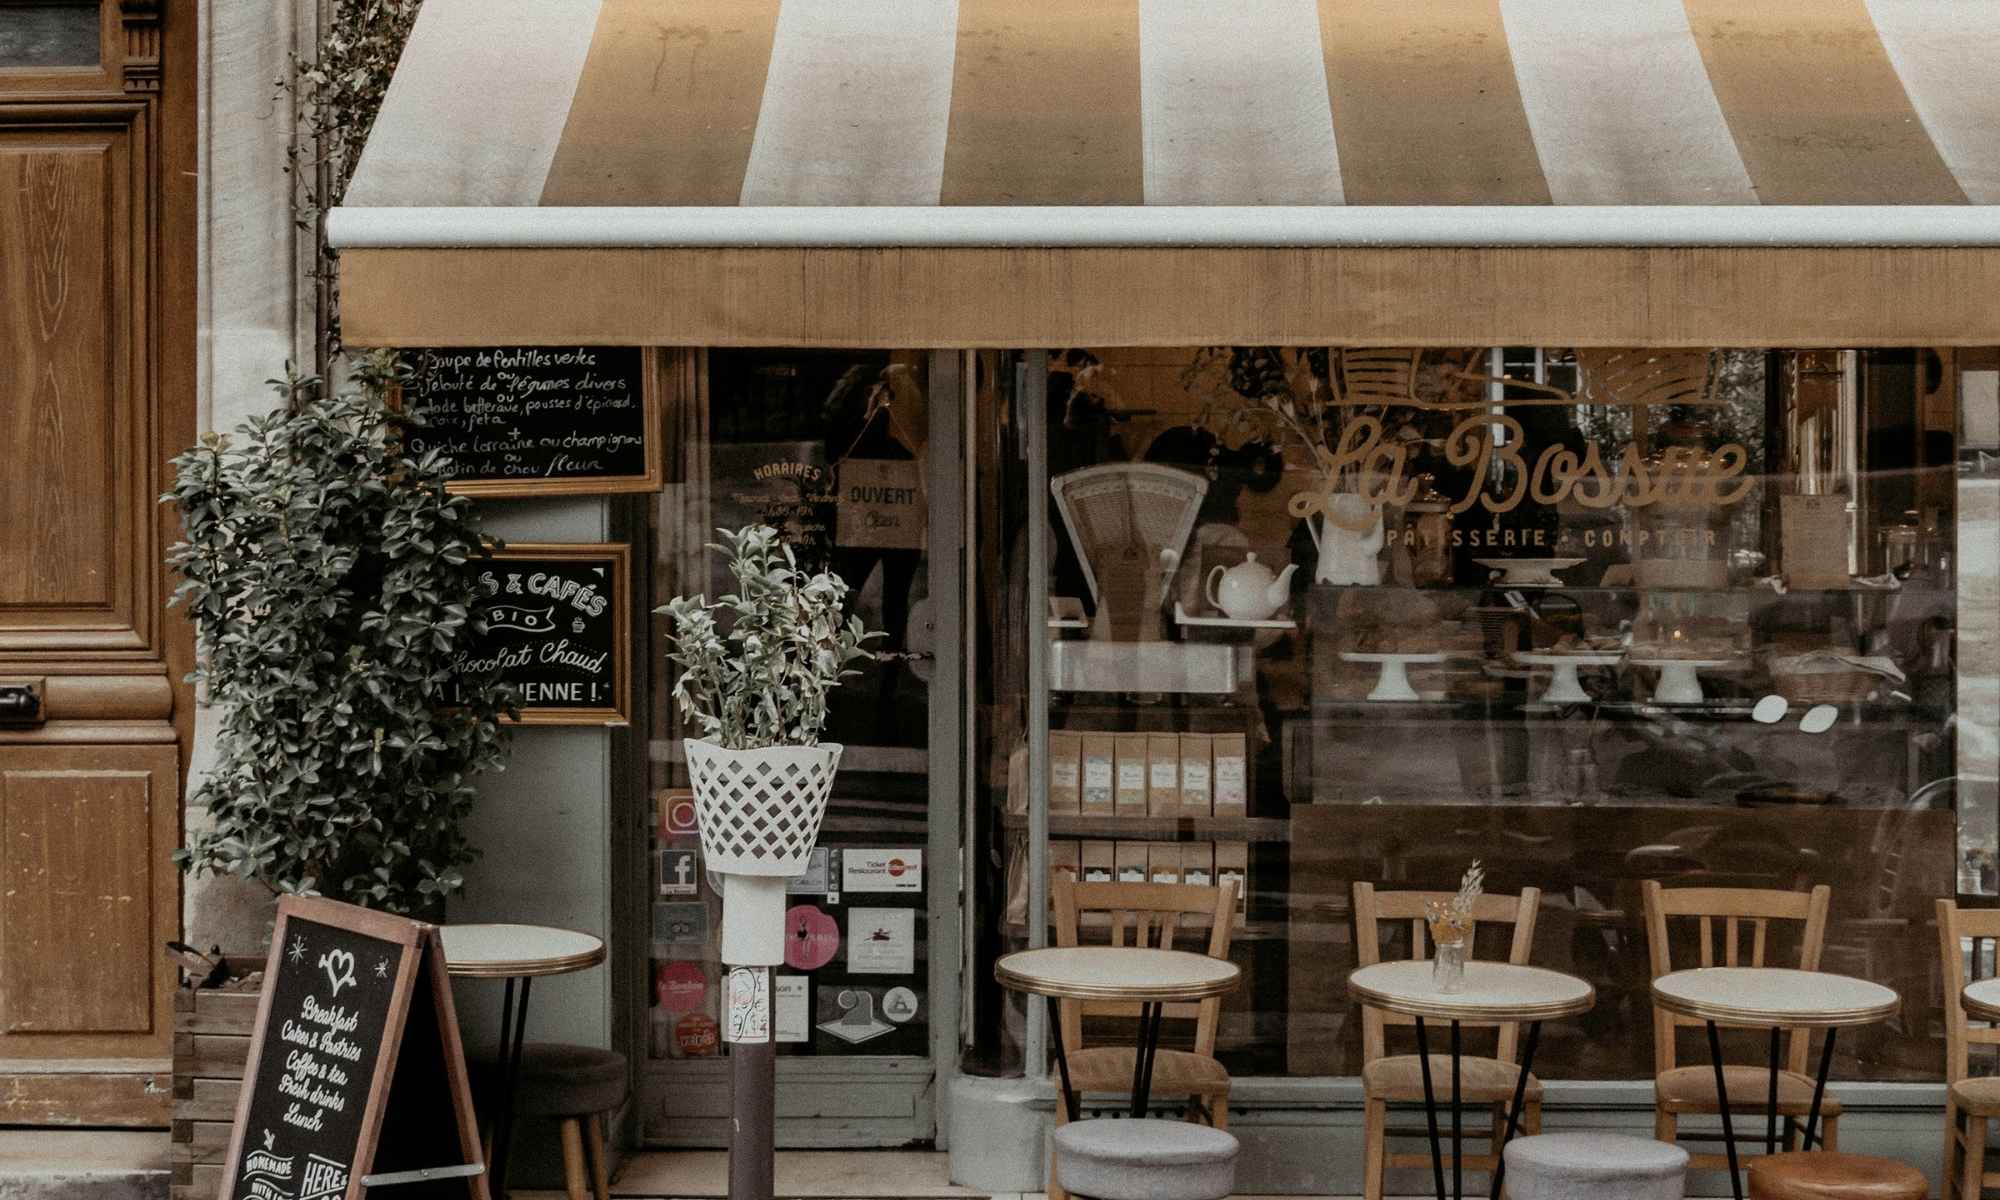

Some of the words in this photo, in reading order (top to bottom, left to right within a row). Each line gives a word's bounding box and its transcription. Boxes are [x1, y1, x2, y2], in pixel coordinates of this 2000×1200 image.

[476, 351, 493, 368] de
[553, 347, 596, 367] vertes
[480, 374, 497, 391] de
[506, 374, 570, 399] légumes
[575, 372, 627, 391] divers
[497, 371, 516, 381] ou
[496, 393, 515, 403] ou
[525, 400, 570, 416] pousses
[467, 413, 507, 433] feta
[540, 436, 561, 448] ou
[480, 458, 497, 474] de
[503, 461, 540, 476] chou
[503, 453, 522, 463] ou
[752, 462, 822, 481] HORAIRES
[850, 486, 913, 505] OUVERT
[1583, 528, 1717, 548] COMPTR
[527, 572, 608, 618] CAFÉS
[492, 610, 538, 626] BIO
[452, 645, 533, 673] hocolat
[539, 638, 608, 674] Chaud
[301, 995, 359, 1034] Breakfast
[281, 1019, 309, 1045] Cakes
[308, 1031, 318, 1048] &
[319, 1034, 362, 1062] Pastries
[286, 1050, 320, 1081] Coffee
[318, 1066, 328, 1080] &
[327, 1065, 349, 1086] tea
[278, 1074, 311, 1100] Fresh
[309, 1087, 346, 1112] drinks
[283, 1102, 324, 1133] Lunch
[246, 1156, 293, 1175] HOMEMADE
[301, 1161, 342, 1198] HERE
